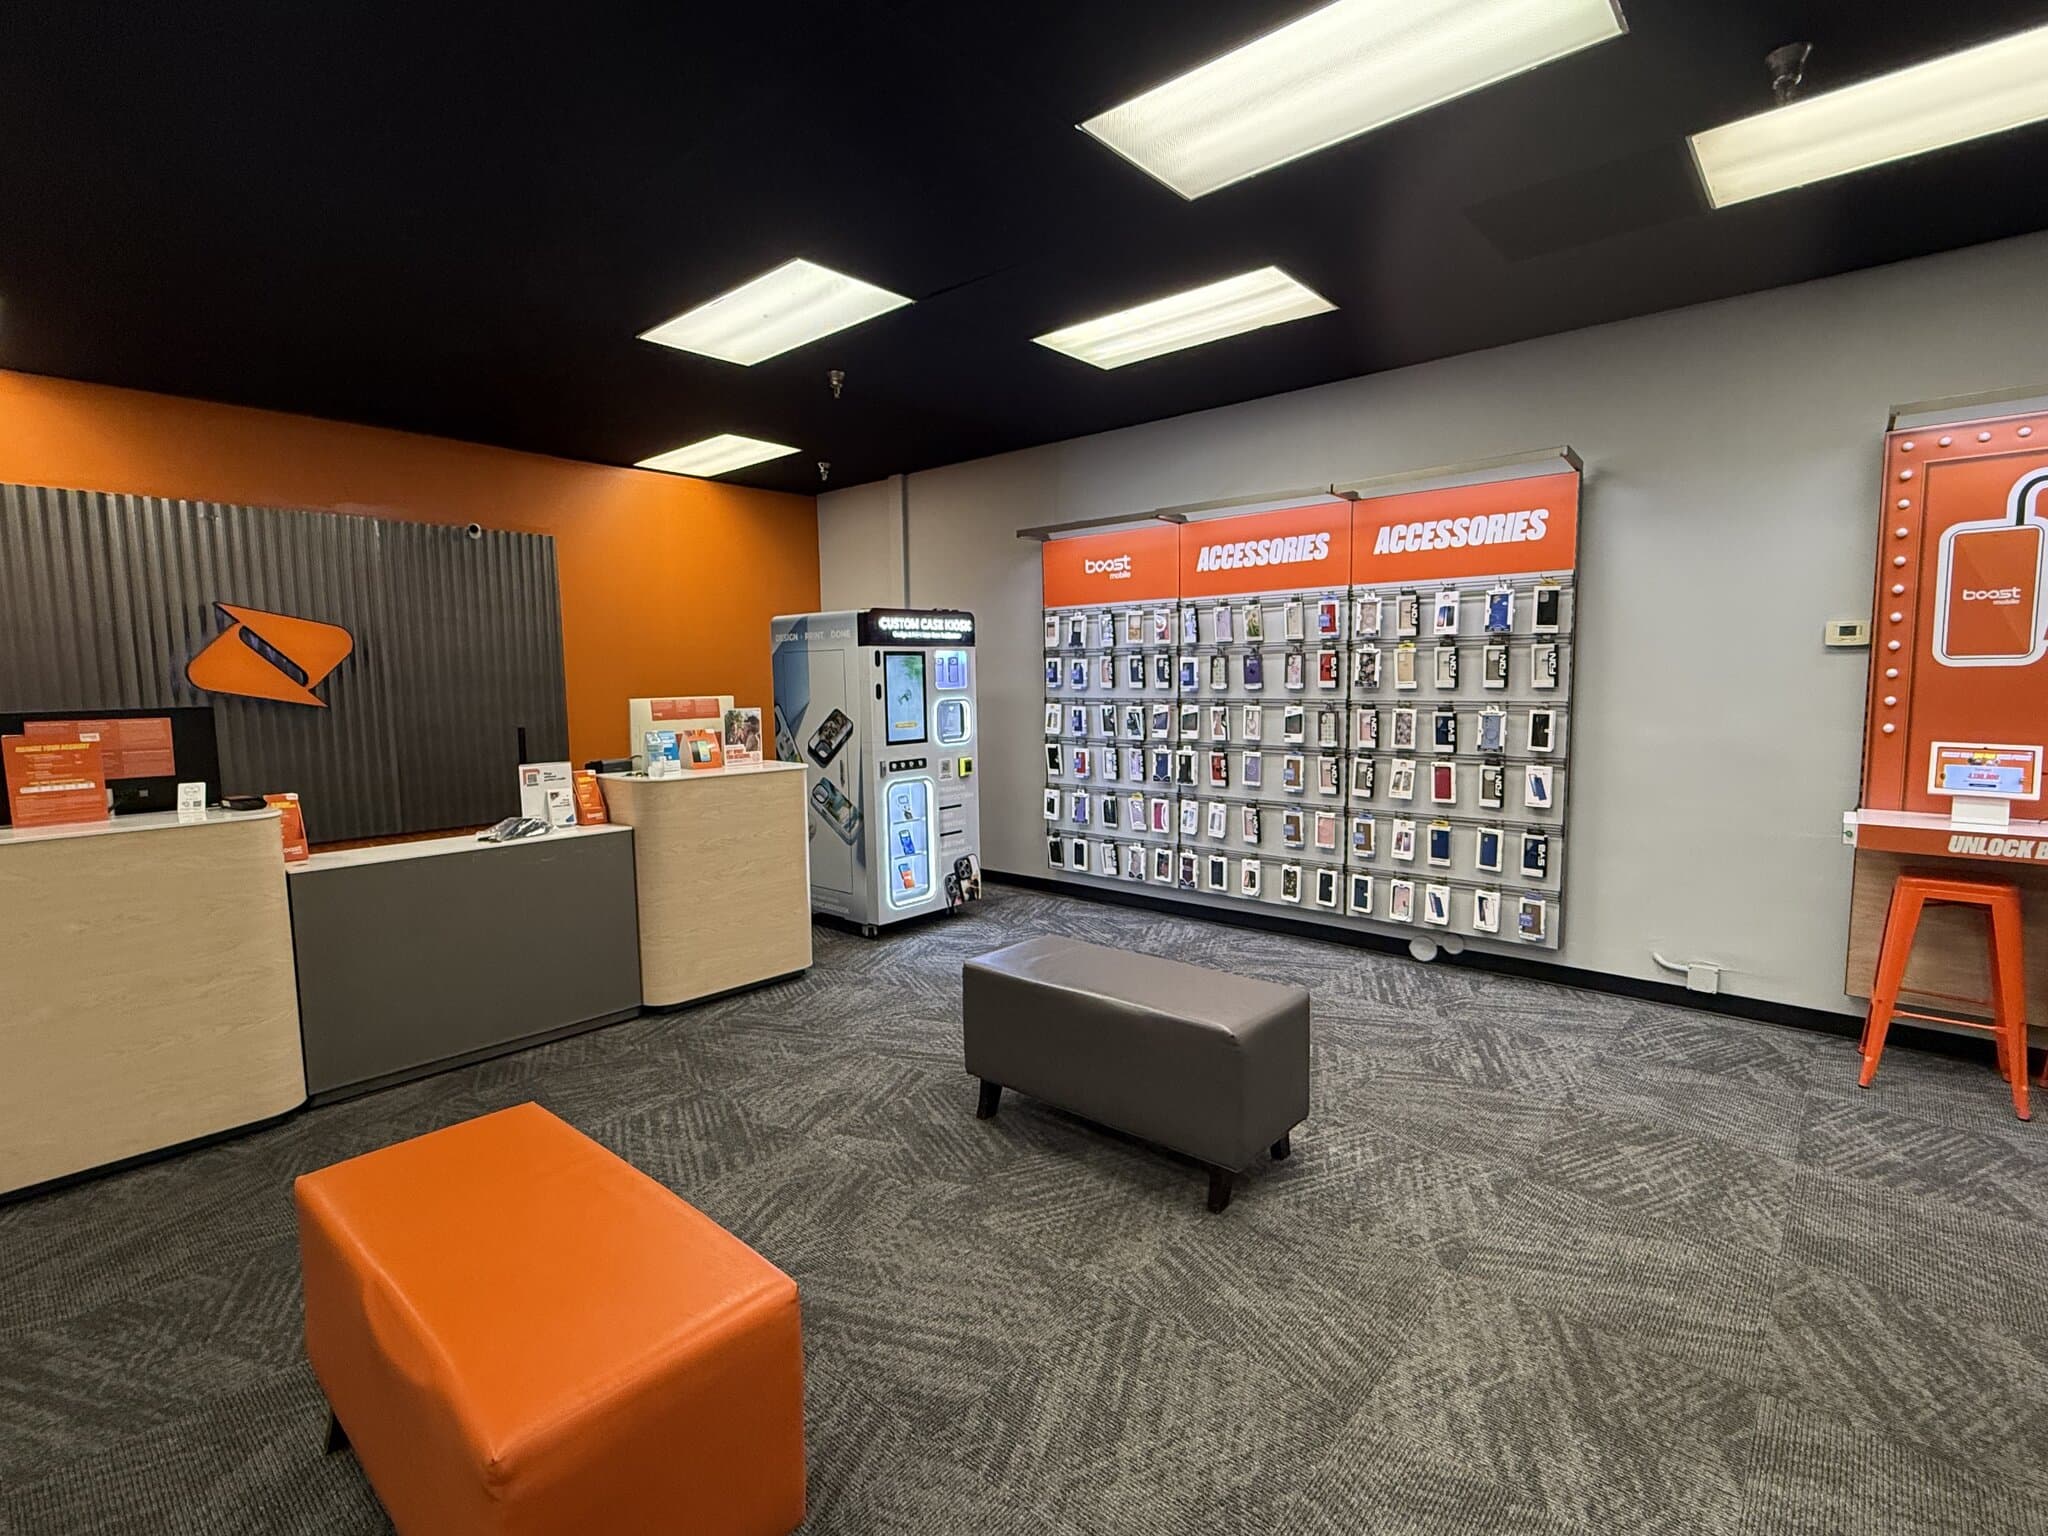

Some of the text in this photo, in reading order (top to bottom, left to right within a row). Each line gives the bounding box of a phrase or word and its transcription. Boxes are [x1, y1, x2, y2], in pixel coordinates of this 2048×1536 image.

[1374, 509, 1550, 555] ACCESSORIES
[1196, 533, 1331, 572] ACCESSORIES
[1085, 555, 1131, 574] boost
[1963, 587, 2021, 601] boost
[878, 616, 920, 630] CUSTOM
[1948, 835, 2036, 859] UNLOCK
